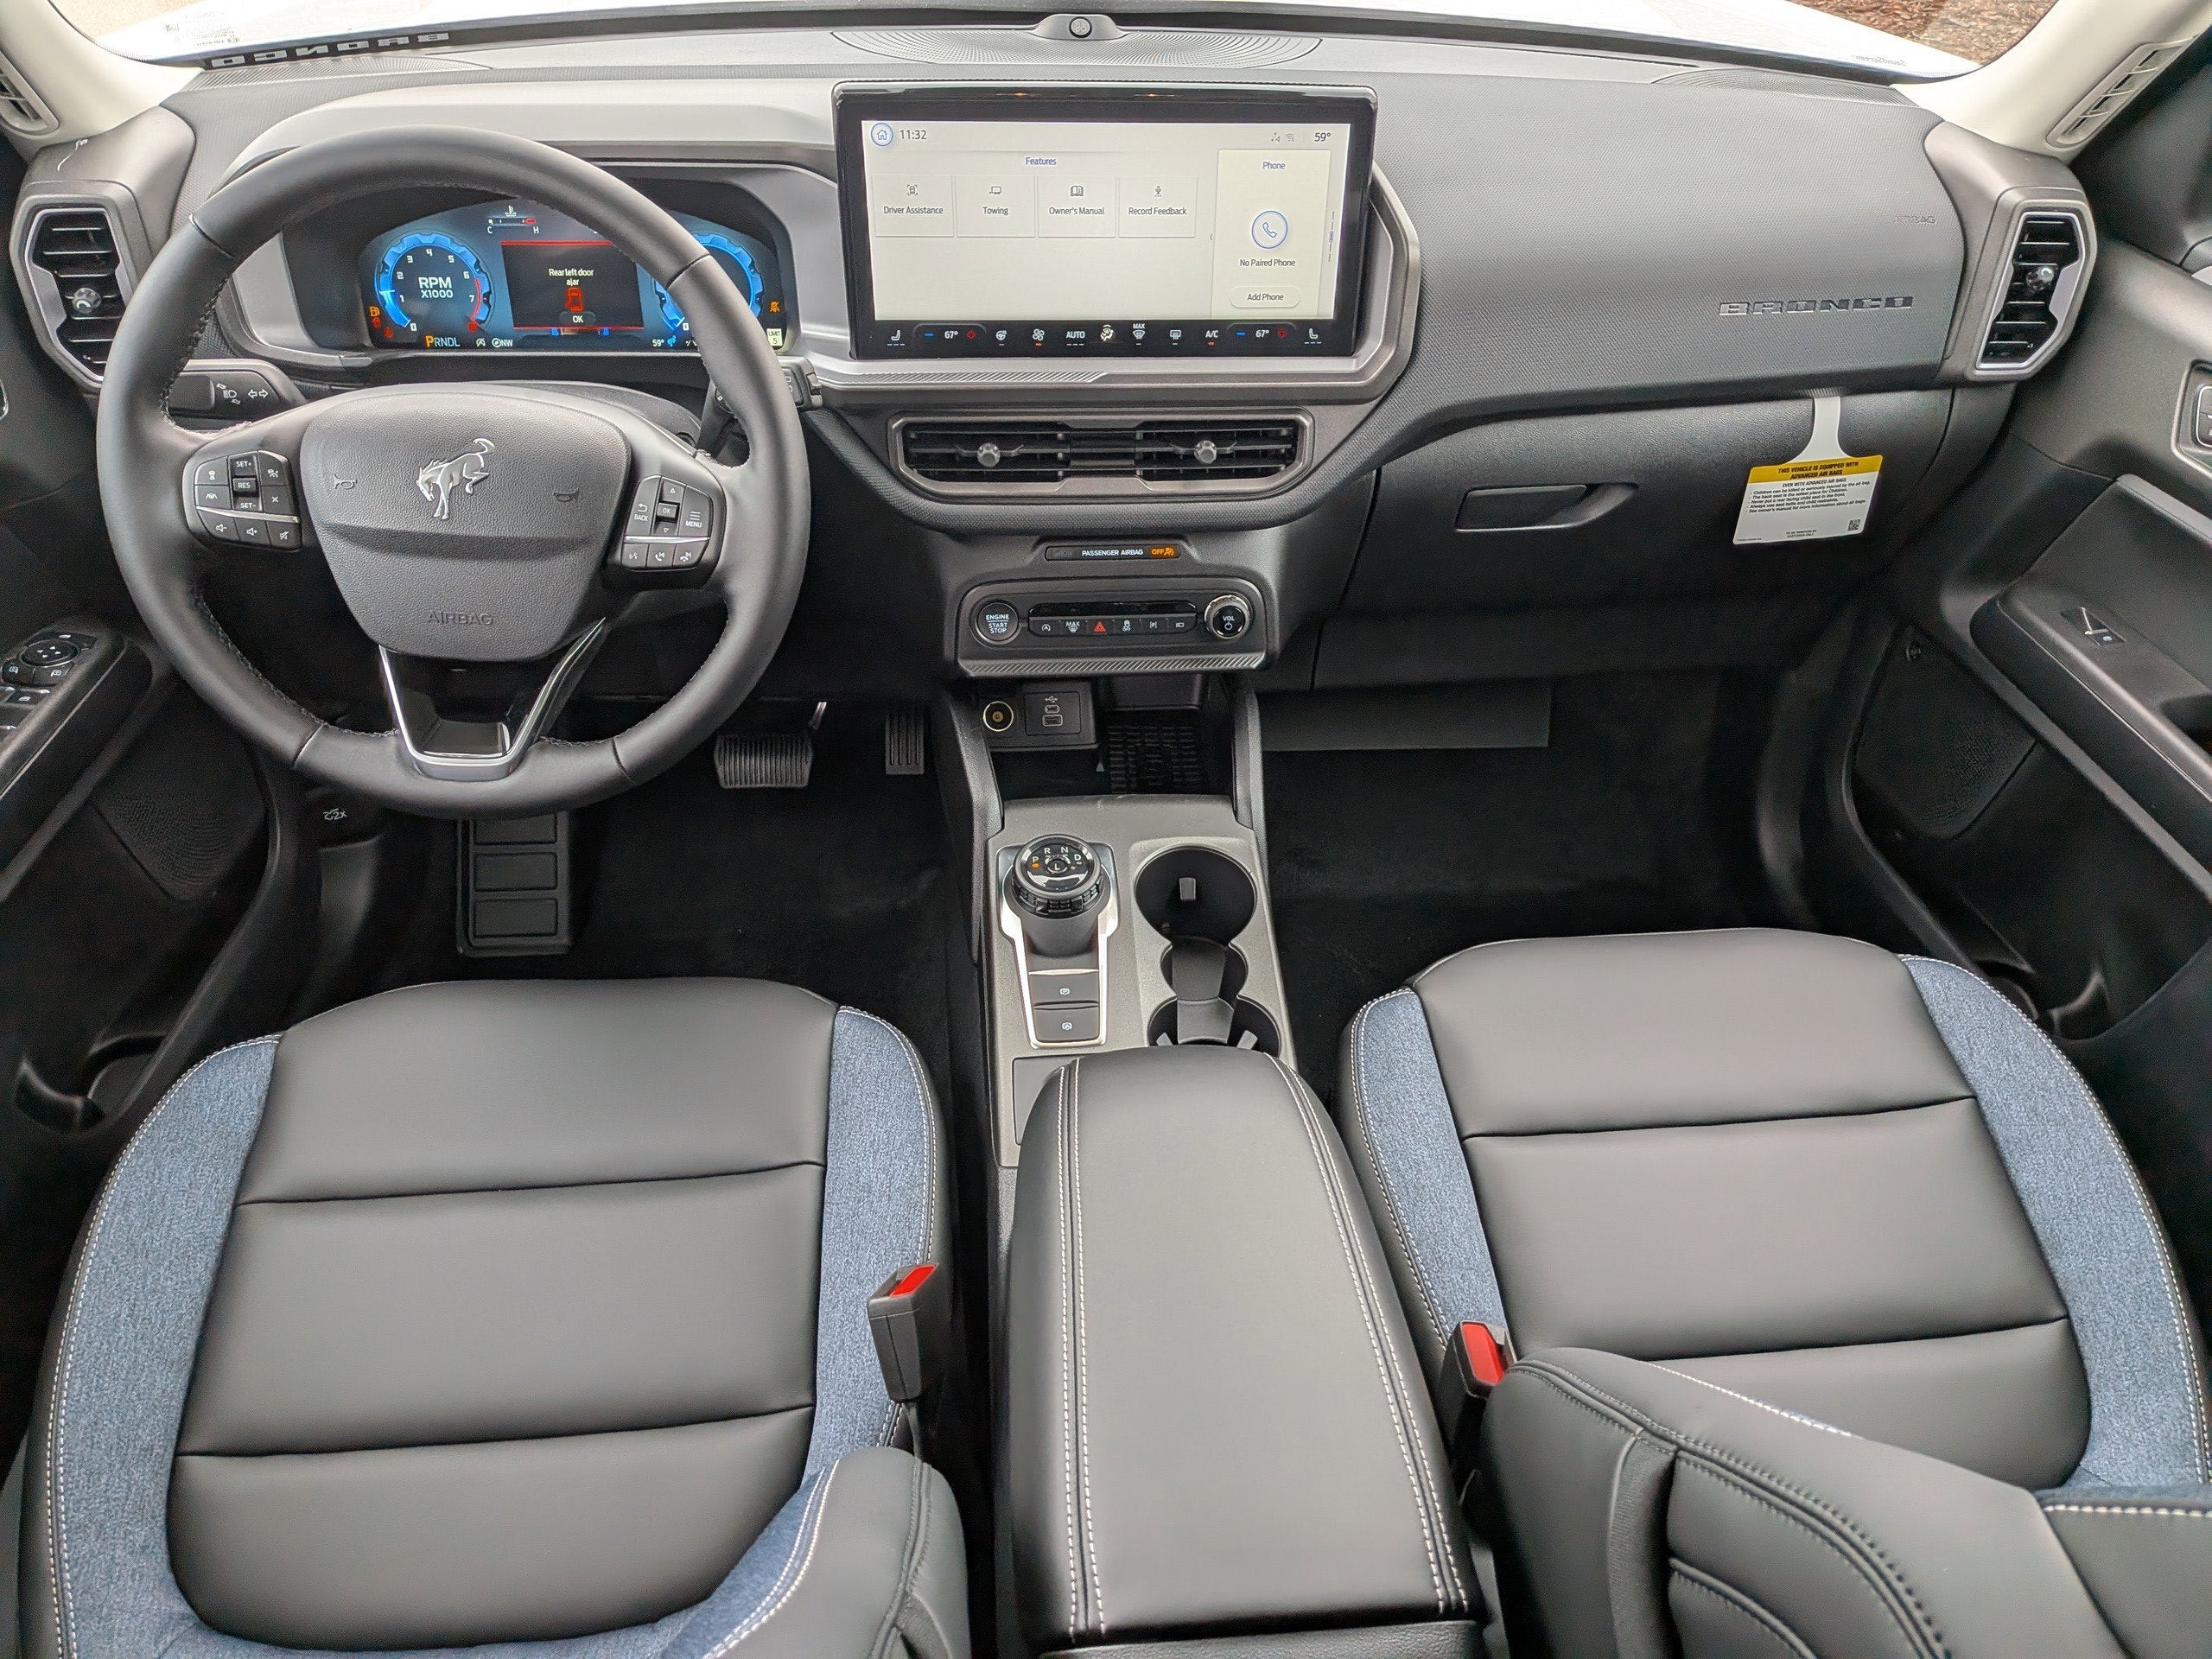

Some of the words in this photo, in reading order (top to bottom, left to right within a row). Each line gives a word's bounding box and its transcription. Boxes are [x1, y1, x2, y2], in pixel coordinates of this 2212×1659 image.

[899, 130, 926, 140] 11:32
[1314, 132, 1331, 142] 59°
[1026, 157, 1057, 166] Features
[983, 207, 1008, 215] Towing
[397, 271, 404, 280] 2
[549, 268, 564, 276] Rear
[565, 268, 577, 276] left
[578, 268, 594, 276] door
[418, 276, 452, 289] RPM
[567, 278, 579, 287] ajar
[421, 289, 453, 299] X1000
[1719, 296, 1914, 315] BRONCO
[944, 330, 958, 340] 67°
[1255, 329, 1269, 338] 67°
[428, 612, 493, 625] AIRBAG
